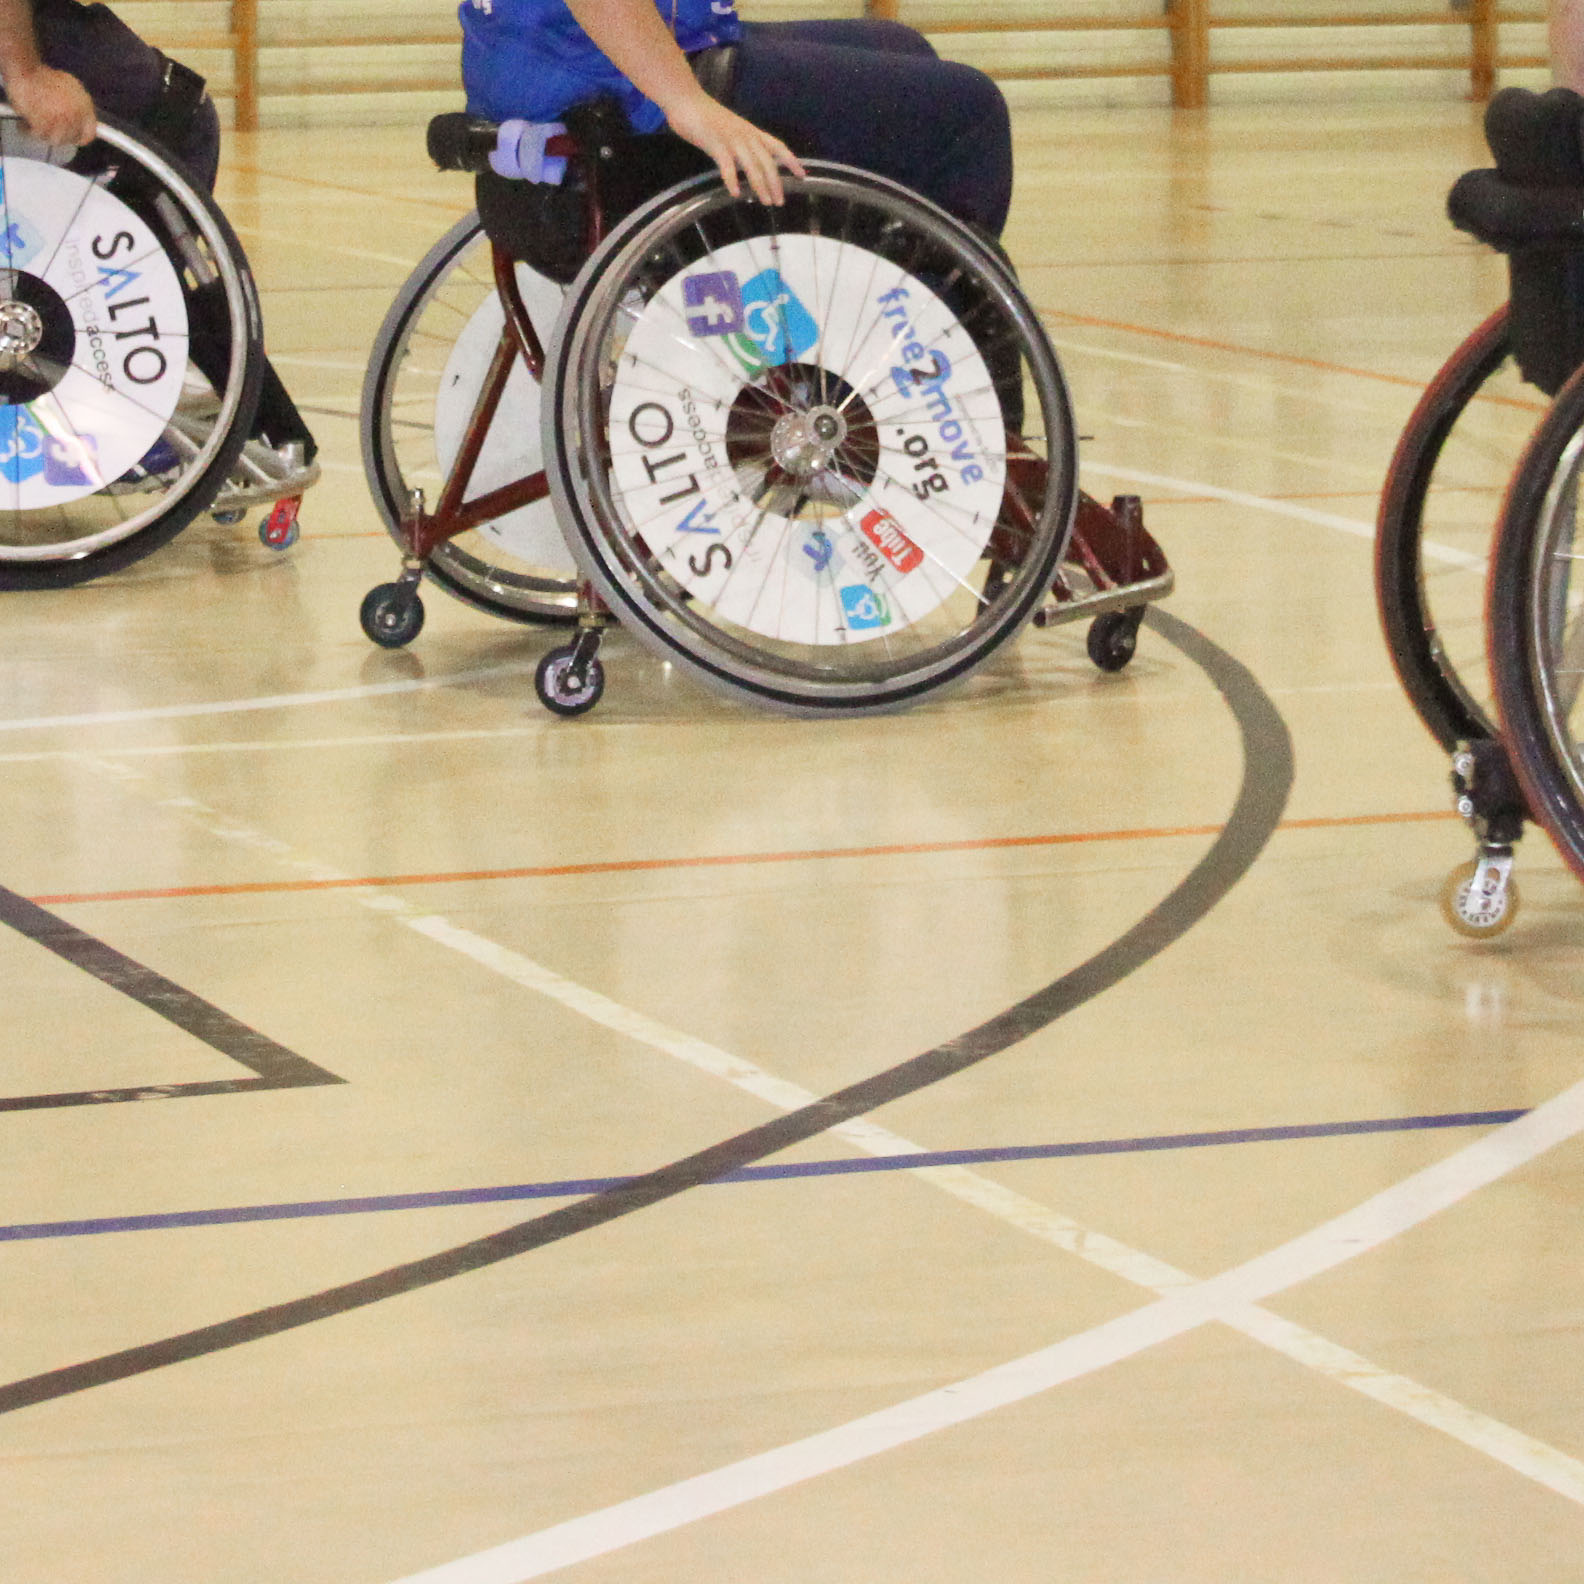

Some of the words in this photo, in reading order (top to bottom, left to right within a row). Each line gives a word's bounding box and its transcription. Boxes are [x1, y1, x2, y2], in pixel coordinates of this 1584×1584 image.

[92, 231, 167, 385] SALTO
[877, 287, 984, 486] free2move
[628, 402, 733, 578] SALTO
[896, 427, 950, 502] .org
